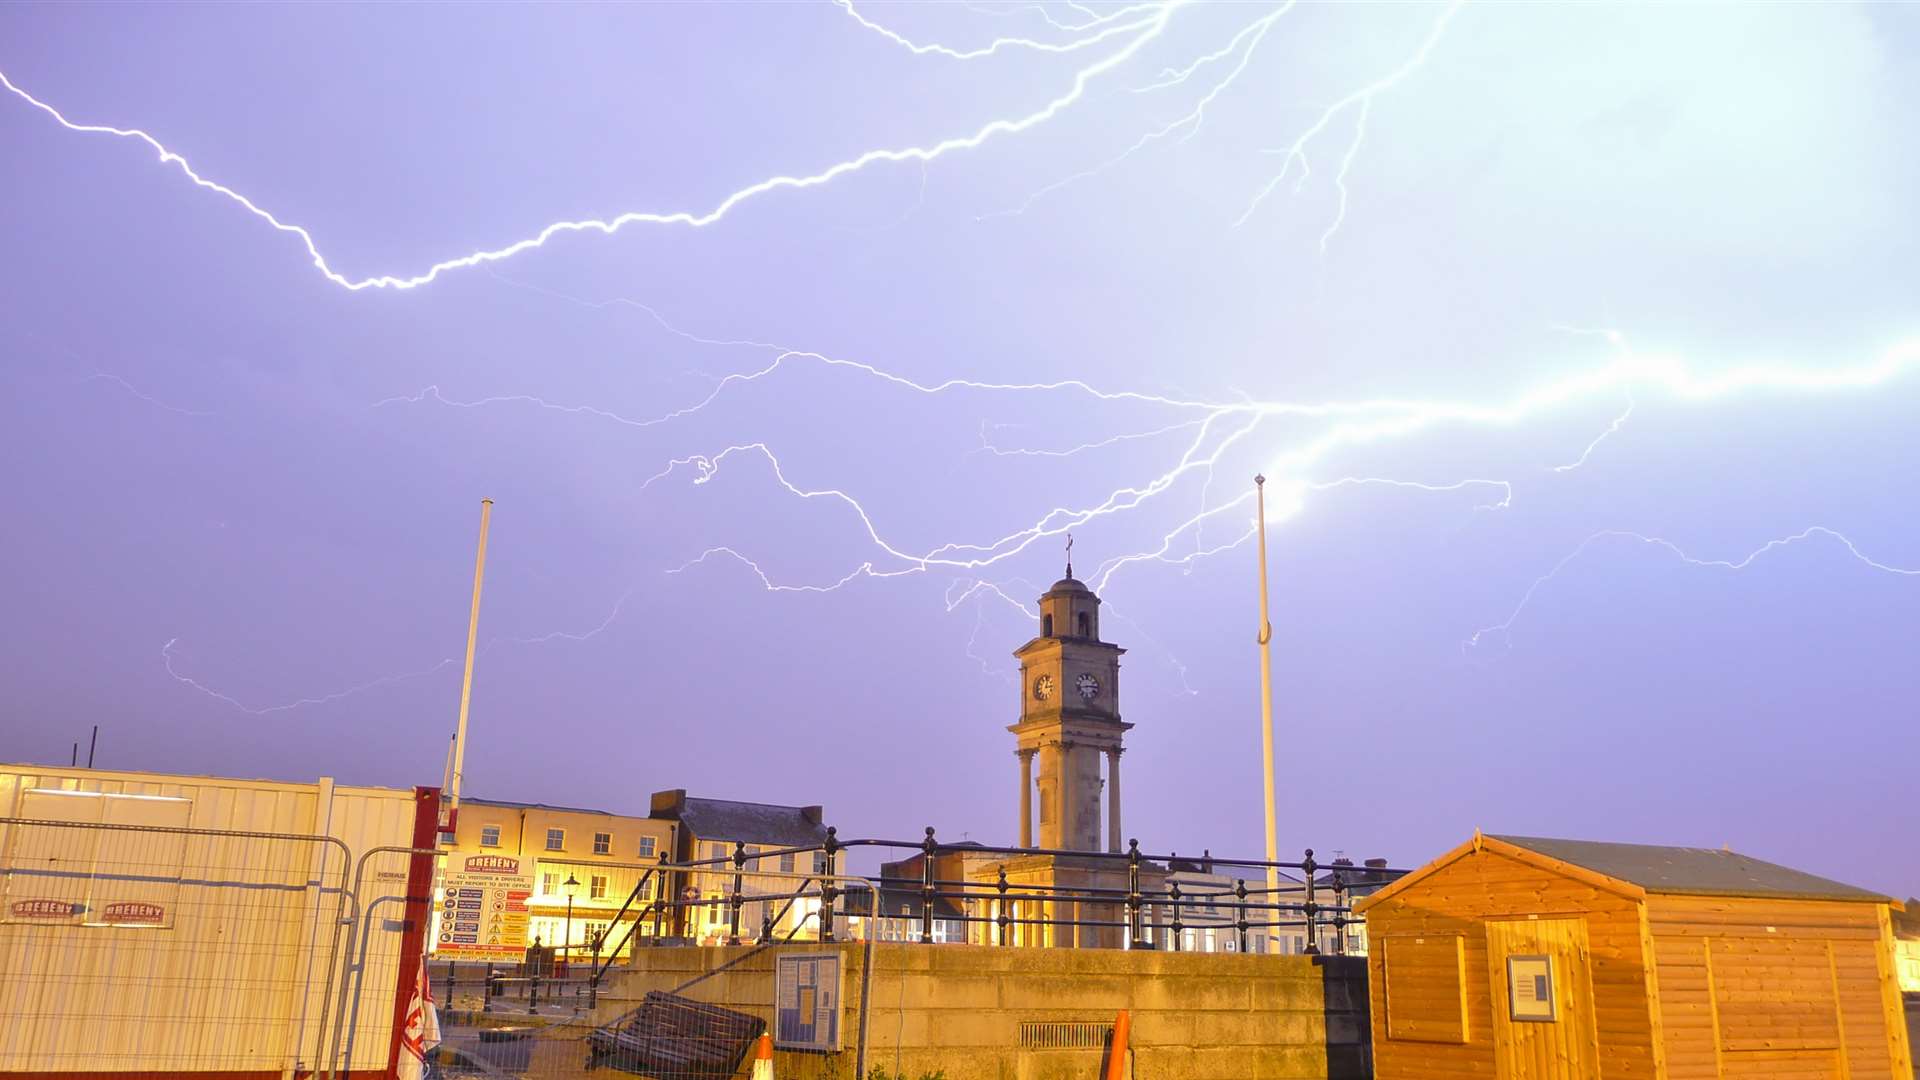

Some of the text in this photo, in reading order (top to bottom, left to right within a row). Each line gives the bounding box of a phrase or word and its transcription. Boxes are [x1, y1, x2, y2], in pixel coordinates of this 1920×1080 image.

[468, 857, 517, 868] BREHENY
[15, 902, 72, 913] BREHENY
[106, 904, 161, 916] BREHENY
